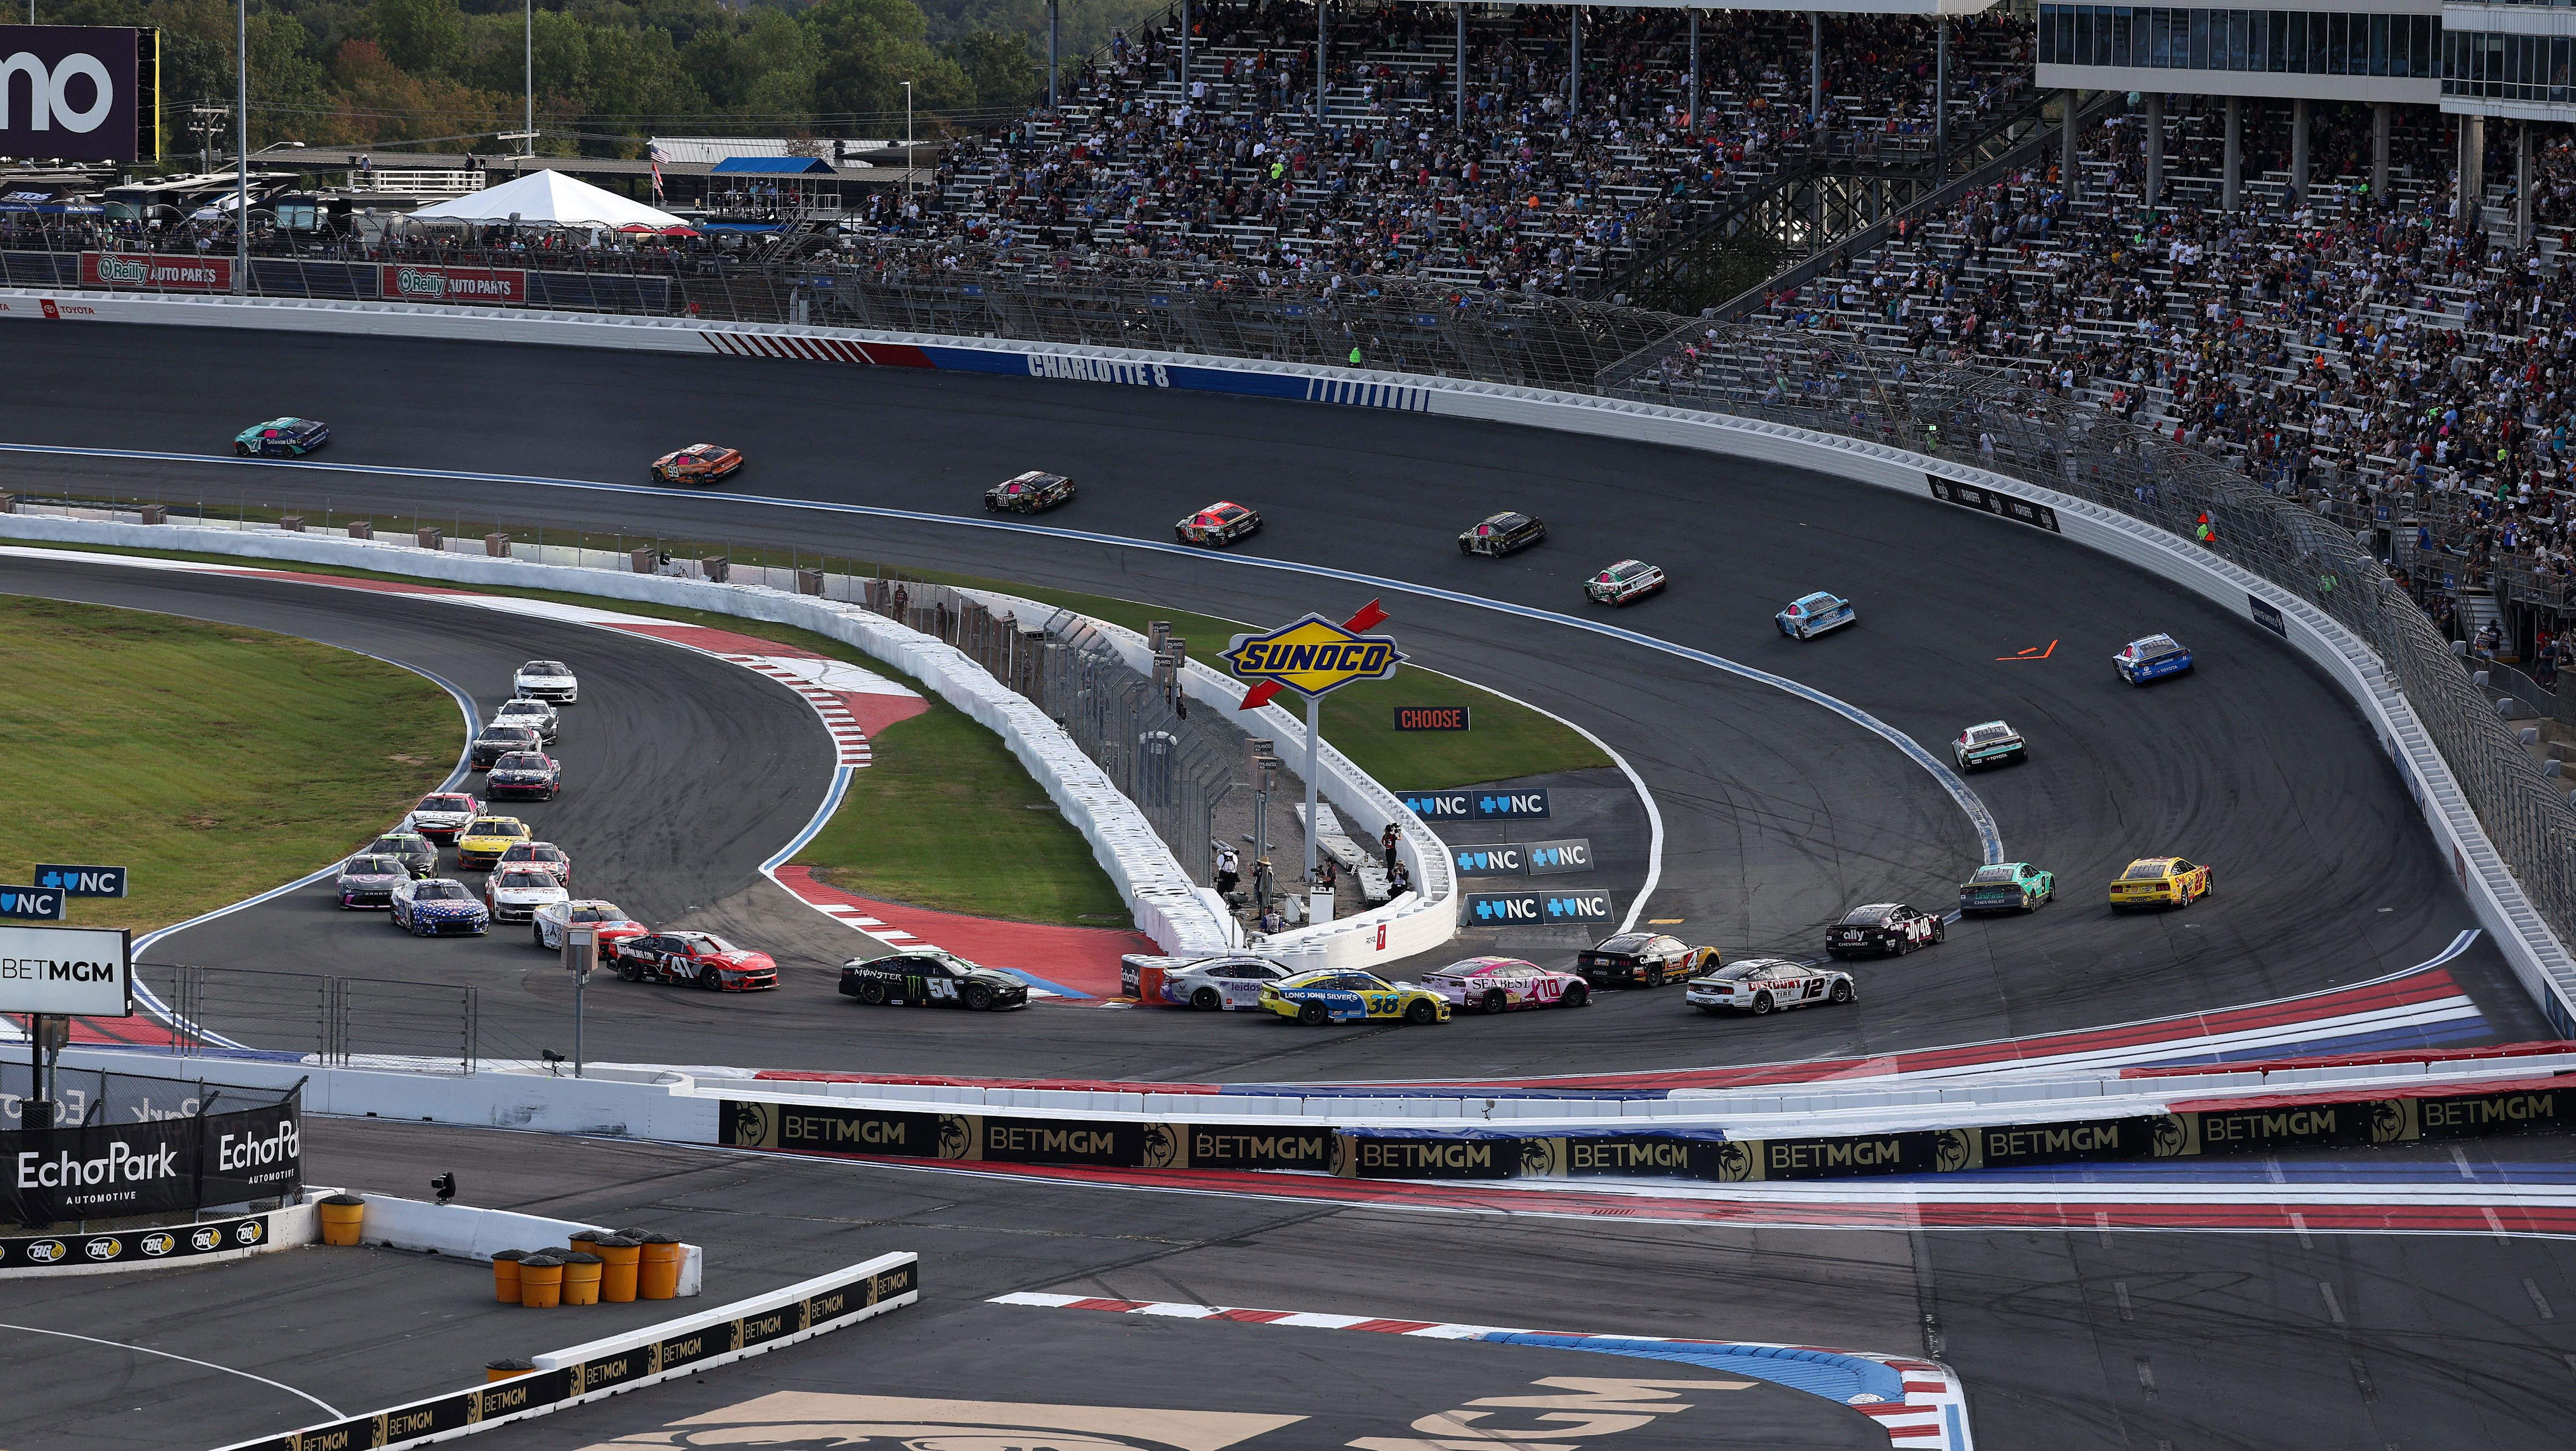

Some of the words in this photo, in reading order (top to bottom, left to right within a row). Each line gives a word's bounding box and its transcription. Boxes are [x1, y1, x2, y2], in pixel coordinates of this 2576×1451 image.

[428, 226, 463, 234] CABARRUS
[99, 257, 147, 283] O'Reilly
[150, 267, 179, 281] AUTO
[181, 268, 216, 283] PARTS
[399, 269, 446, 297] O'Reilly
[448, 278, 475, 293] AUTO
[477, 279, 511, 295] PARTS
[60, 306, 95, 315] TOYOTA
[1027, 355, 1150, 386] CHARLOTTE
[1154, 364, 1170, 388] 8
[251, 439, 262, 450] 71
[668, 465, 679, 478] 99
[1961, 488, 1981, 504] PLAYOFFS
[2015, 503, 2033, 518] PLAYOFFS
[1185, 527, 1194, 539] 19
[1638, 577, 1654, 586] Castrol
[1821, 611, 1840, 623] BUSCH
[1821, 619, 1844, 629] CHEVROLET
[1240, 643, 1384, 672] SUNOCO
[2161, 665, 2178, 673] TOYOTA
[1401, 709, 1462, 729] CHOOSE
[1436, 796, 1466, 814] NC
[1512, 794, 1542, 813] NC
[1488, 850, 1519, 870] NC
[1558, 845, 1587, 865] NC
[80, 872, 116, 893] NC
[2195, 871, 2203, 892] 22
[16, 893, 53, 915] NC
[1506, 898, 1537, 919] NC
[1577, 897, 1606, 917] NC
[1379, 930, 1384, 946] 7
[1844, 929, 1864, 941] ally
[1905, 920, 1920, 943] ally
[1920, 917, 1931, 937] 48
[2, 959, 113, 983] BETMGM
[671, 956, 694, 978] 41
[1688, 955, 1698, 973] 4
[925, 977, 960, 1000] 54
[1232, 982, 1260, 991] leidos
[1472, 978, 1498, 990] SEA
[1501, 978, 1528, 989] BEST
[1541, 979, 1559, 998] 10
[1748, 977, 1801, 991] DISCOUNT
[1801, 977, 1825, 999] 12
[1307, 992, 1326, 1000] JOHN
[1327, 992, 1358, 1001] SILVER'S
[1366, 994, 1399, 1014] 38
[2426, 1093, 2553, 1127] BETMGM
[786, 1116, 905, 1144] BETMGM
[2207, 1109, 2336, 1141] BETMGM
[219, 1119, 299, 1172] EchoPa
[990, 1127, 1113, 1154] BETMGM
[1196, 1135, 1322, 1160] BETMGM
[1990, 1125, 2118, 1157] BETMGM
[1364, 1144, 1491, 1168] BETMGM
[1575, 1143, 1688, 1168] BETMGM
[1772, 1140, 1900, 1168] BETMGM
[17, 1141, 178, 1189] EchoPark
[248, 1168, 295, 1185] AUTOMOTIVE
[66, 1190, 137, 1205] AUTOMOTIVE
[879, 1270, 907, 1296] BETMGM
[811, 1294, 843, 1319] BETMGM
[745, 1315, 781, 1340] BETMGM
[663, 1337, 703, 1363] BETMGM
[587, 1359, 627, 1385] BETMGM
[484, 1387, 527, 1413] BETMGM
[390, 1409, 433, 1437] BETMGM
[304, 1430, 348, 1451] BETMGM
